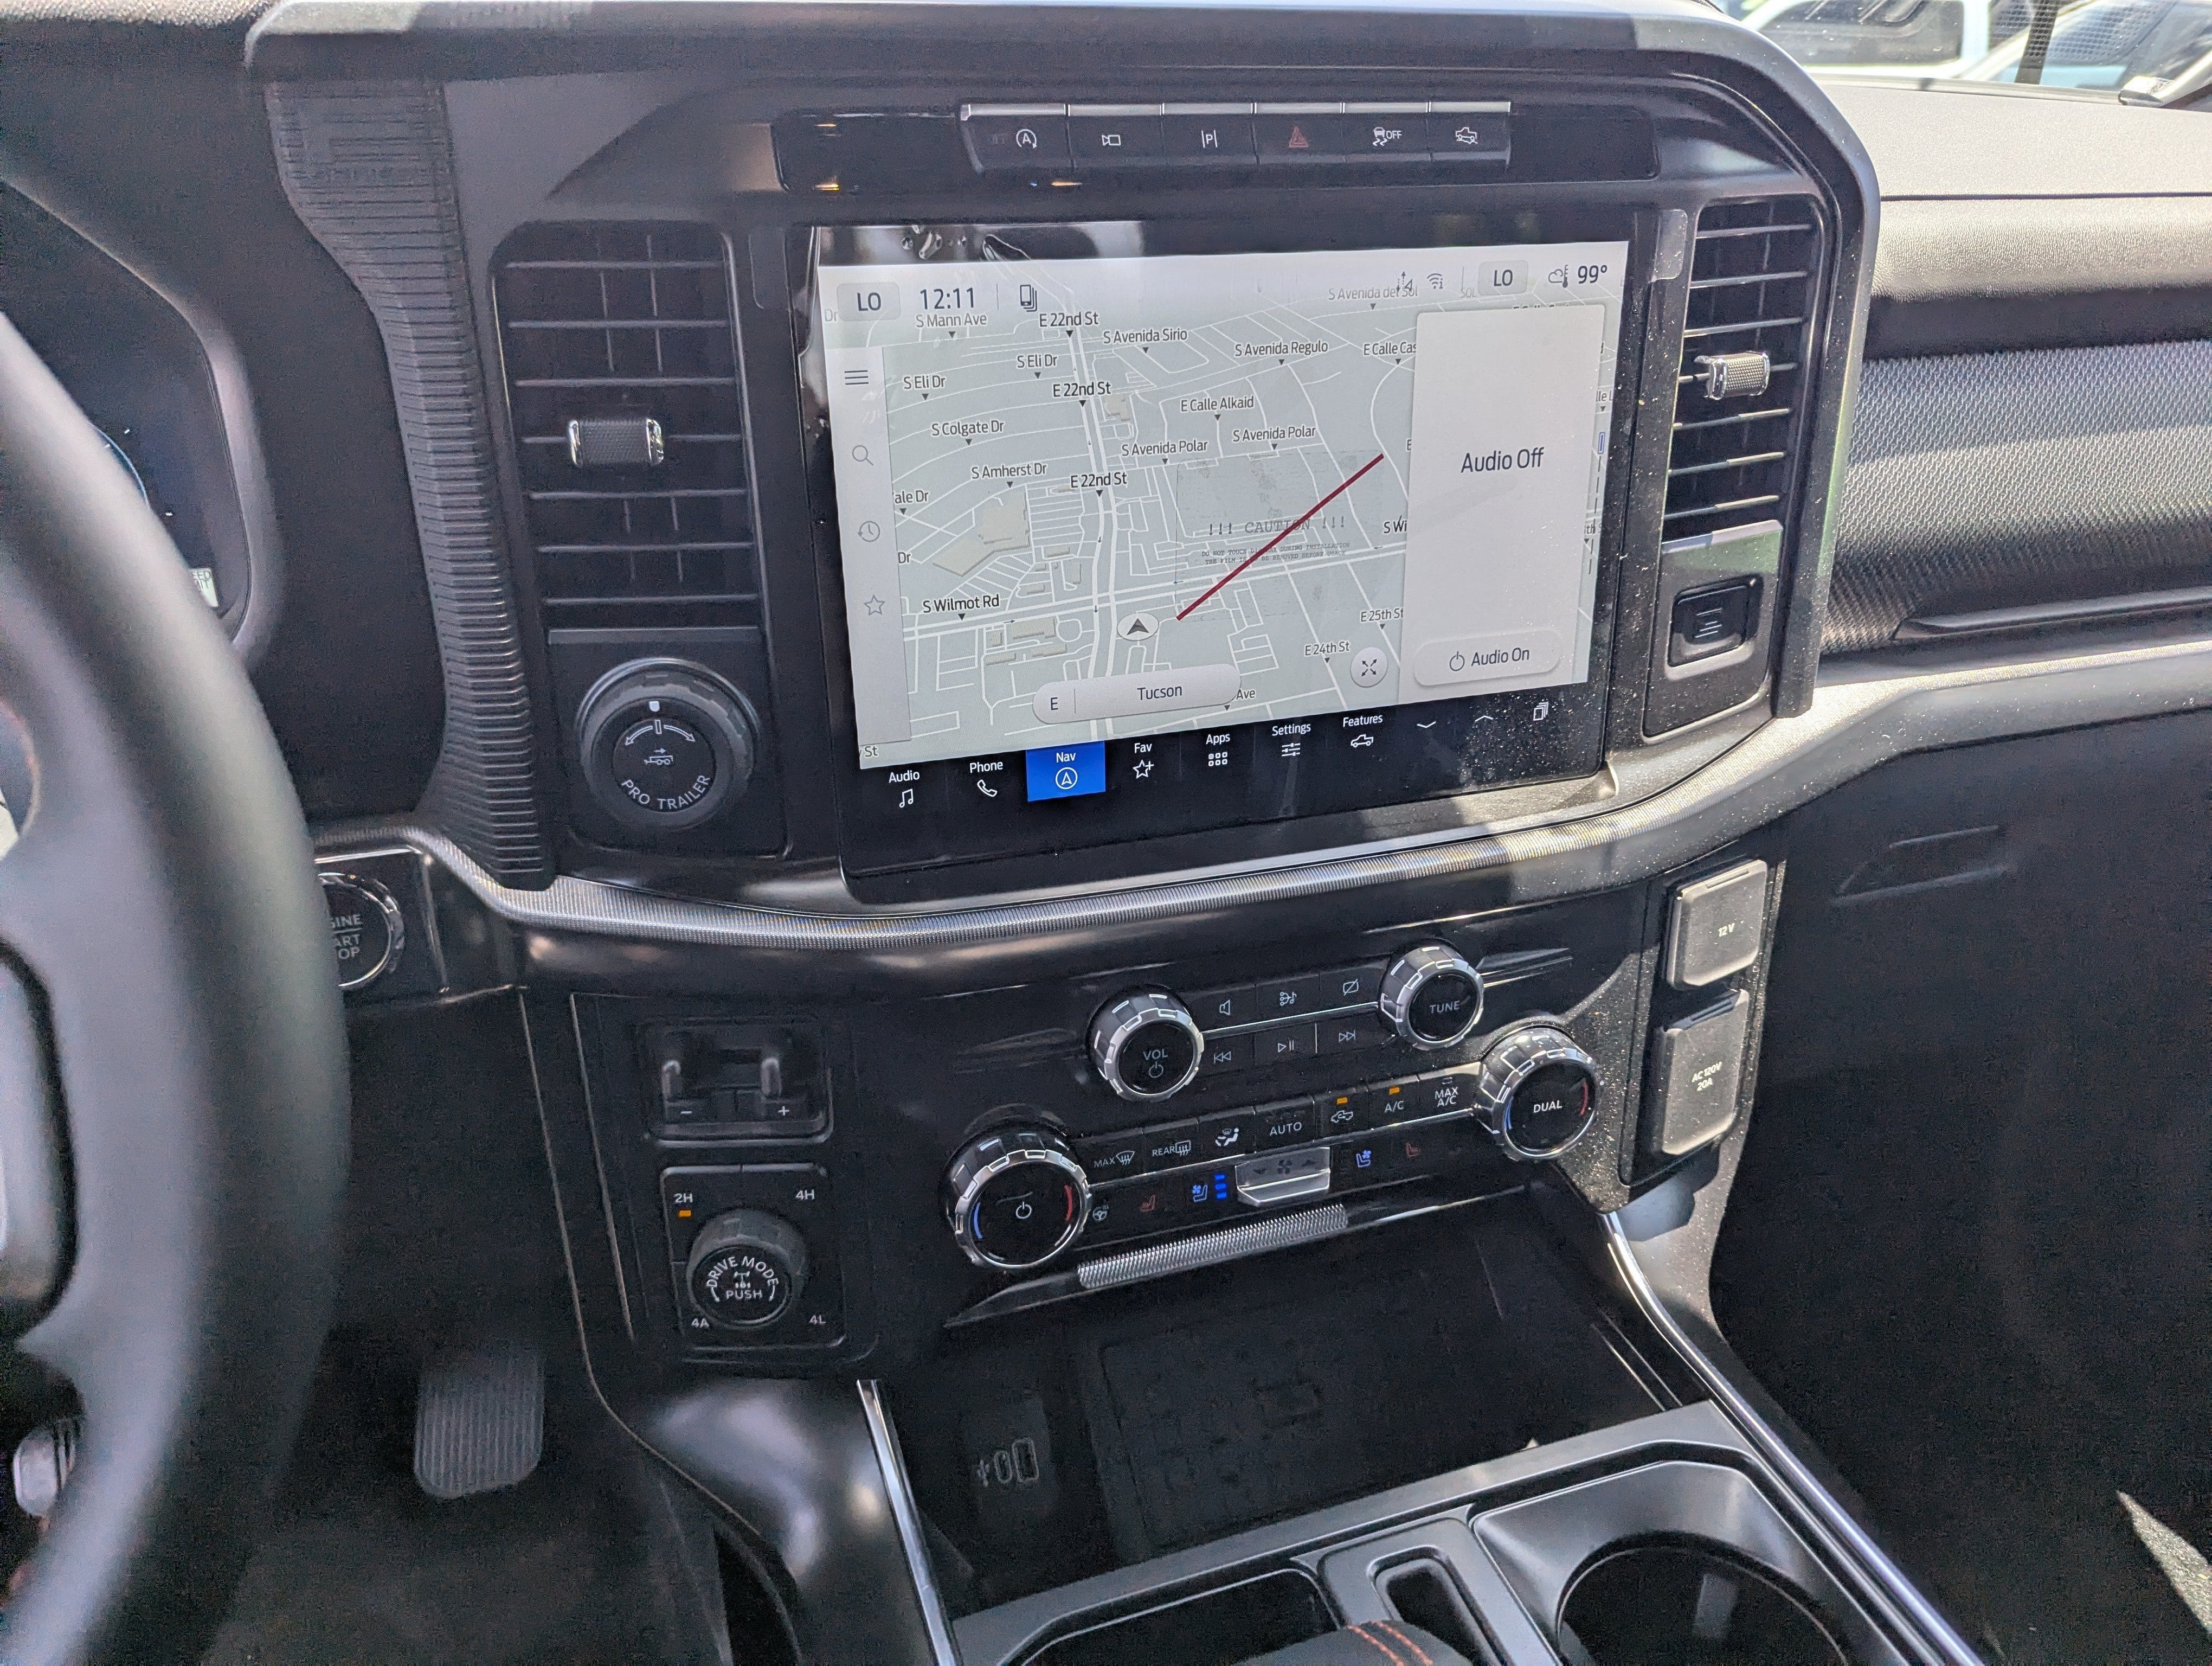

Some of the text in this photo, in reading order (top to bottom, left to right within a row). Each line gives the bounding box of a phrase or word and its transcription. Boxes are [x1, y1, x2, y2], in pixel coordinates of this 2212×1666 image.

[1386, 130, 1403, 140] OFF
[1494, 269, 1513, 287] LO
[1578, 265, 1607, 284] 99°
[920, 287, 976, 310] 12:11
[1328, 289, 1335, 300] S
[1338, 286, 1381, 300] Avenida
[857, 292, 882, 311] LO
[824, 309, 838, 322] Dr
[916, 313, 987, 328] S Mann Ave
[1039, 311, 1099, 327] E 22nd St
[1103, 328, 1188, 344] S Avenida Sirio
[1235, 340, 1328, 356] S Avenida Regulo
[1363, 344, 1370, 356] E
[1372, 342, 1398, 355] Calle
[1017, 354, 1058, 368] S Eli Dr
[904, 375, 946, 389] S Eli Dr
[1053, 381, 1111, 397] E 22nd St
[1181, 396, 1255, 412] E Calle Alkaid
[931, 420, 1004, 438] S Colgate Dr
[1232, 426, 1316, 443] S Avenida Polar
[1122, 440, 1208, 457] S Avenida Polar
[1461, 447, 1545, 473] Audio Off
[972, 463, 1047, 479] S Amherst Dr
[1070, 471, 1128, 488] E 22nd St
[893, 490, 929, 504] ale Dr
[1383, 522, 1391, 534] S
[1306, 542, 1351, 550] INSTALLATION
[898, 552, 911, 564] Dr
[1272, 553, 1299, 561] REMOVED
[923, 594, 1000, 613] S Wilmot Rd
[1360, 607, 1404, 623] E 25th St
[1304, 641, 1350, 656] E 24th St
[1470, 647, 1530, 667] Audio On
[1136, 684, 1183, 701] Tucson
[1236, 689, 1256, 700] Ave
[1050, 697, 1058, 710] E
[1342, 713, 1383, 728] Features
[1271, 722, 1311, 737] Settings
[1205, 733, 1231, 746] Apps
[865, 745, 878, 757] St
[1134, 742, 1153, 753] Fav
[1056, 751, 1076, 762] Nav
[969, 760, 1004, 773] Phone
[888, 770, 921, 783] Audio
[621, 774, 710, 810] PRO TRAILER
[1429, 1000, 1460, 1014] TUNE
[1143, 1049, 1169, 1060] VOL
[1691, 1061, 1722, 1083] AC 120V
[1696, 1078, 1713, 1092] 20A
[1435, 1086, 1459, 1100] MAX
[1384, 1100, 1405, 1113] A/C
[1437, 1095, 1457, 1107] A/C
[1533, 1099, 1562, 1114] DUAL
[1269, 1120, 1303, 1137] AUTO
[1152, 1145, 1175, 1157] REAR
[1094, 1157, 1116, 1168] MAX
[674, 1193, 693, 1203] 2H
[795, 1189, 815, 1201] 4H
[706, 1255, 779, 1289] DRIVE MODE
[725, 1288, 763, 1301] PUSH
[691, 1317, 709, 1328] 4A
[809, 1314, 826, 1325] 4L
